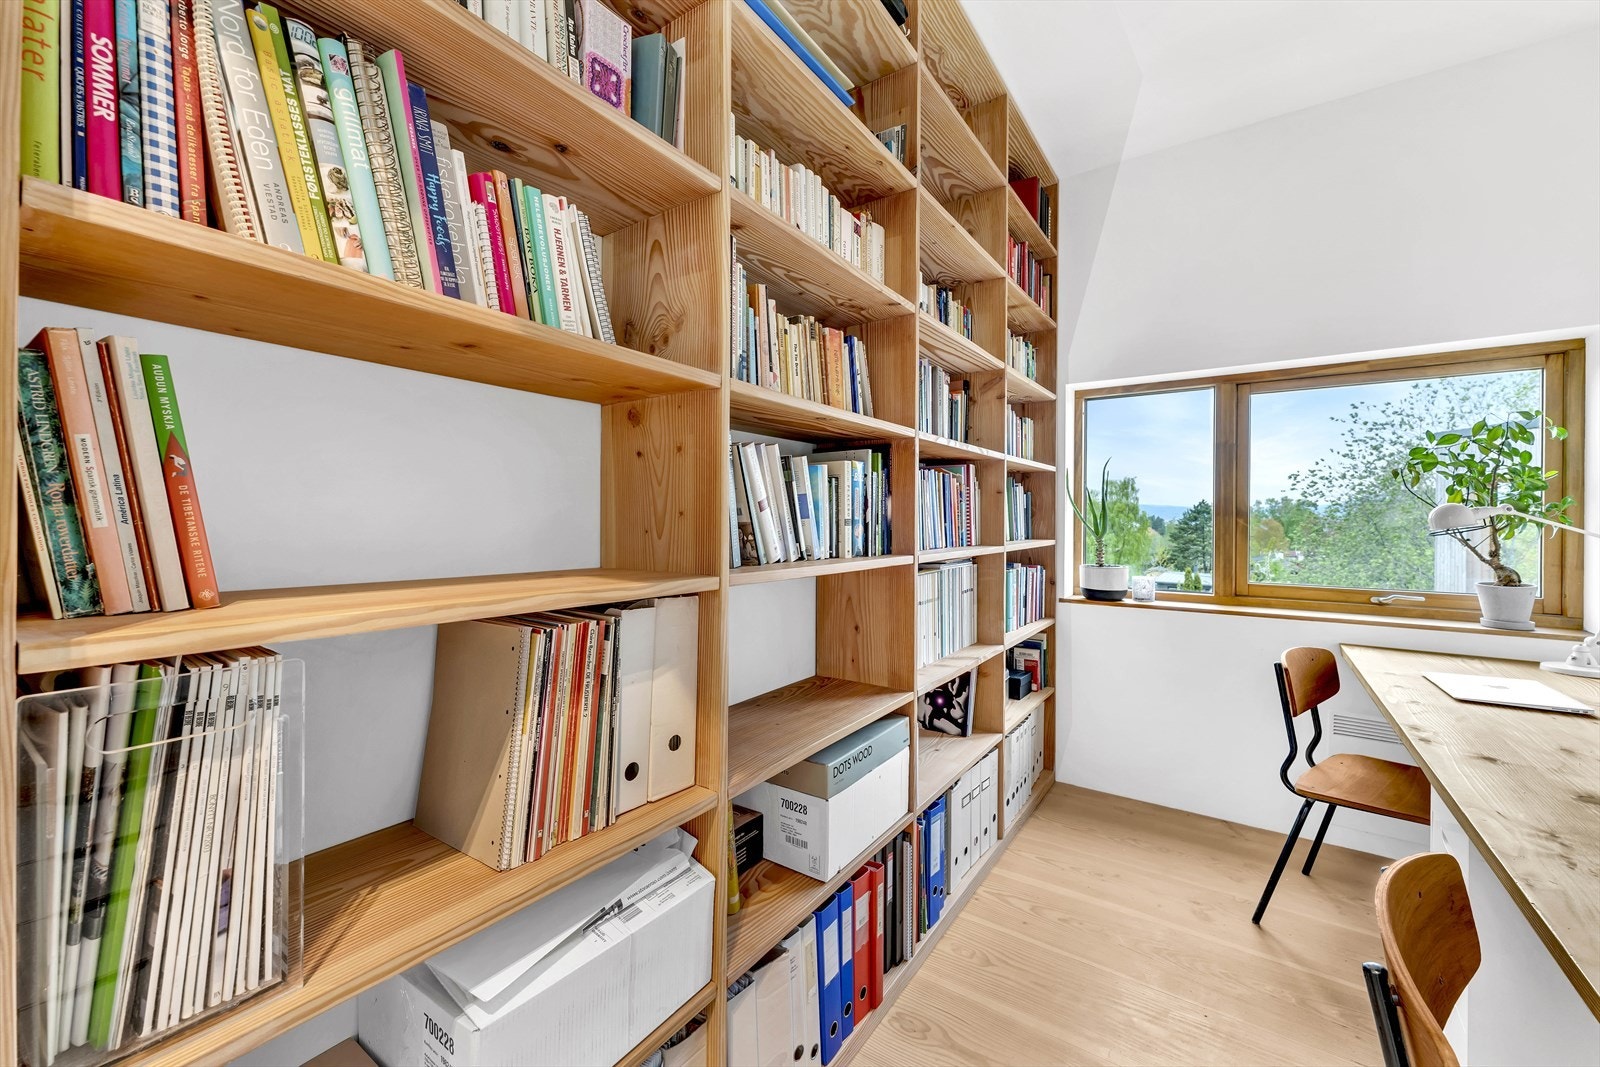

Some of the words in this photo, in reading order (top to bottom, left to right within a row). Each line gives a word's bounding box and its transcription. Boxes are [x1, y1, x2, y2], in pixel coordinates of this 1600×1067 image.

[179, 32, 189, 60] Jorge
[218, 0, 254, 60] Nord
[74, 66, 84, 96] QUICHES
[90, 32, 116, 122] SOMMER
[181, 66, 192, 92] Tapas
[232, 66, 258, 102] for
[280, 68, 294, 96] MAT
[77, 100, 85, 127] PASTRIES
[185, 102, 195, 122] små
[262, 50, 278, 90] Basic
[274, 100, 296, 161] asiatisk
[242, 108, 274, 170] Eden
[334, 88, 370, 170] grillmat
[186, 124, 198, 181] delikatesser
[287, 98, 320, 200] FØRSTEKLASSES
[191, 182, 200, 198] fra
[414, 106, 429, 132] IRINA
[426, 173, 440, 214] Happy
[433, 214, 450, 252] Foods
[263, 183, 278, 222] VIESTAD
[273, 182, 288, 224] ANDREAS
[436, 156, 470, 284] fiskekokeboka
[534, 196, 552, 292] HELSEREVOLUSJONEN
[554, 228, 567, 268] HJERNEN
[528, 258, 538, 294] BOKA
[560, 277, 572, 312] TARMEN
[27, 368, 46, 411] ASTRID
[152, 364, 167, 394] AUDUN
[160, 396, 175, 430] MYSKJA
[35, 414, 59, 474] LINDGREN
[80, 438, 92, 464] MODERN
[86, 466, 97, 490] Spansk
[113, 474, 124, 496] Latina
[178, 484, 190, 496] DE
[18, 454, 26, 478] VERBOS
[32, 514, 44, 552] CONJUGADOS
[44, 482, 66, 516] Ronja
[90, 490, 103, 522] grammatik
[116, 496, 130, 524] América
[182, 498, 200, 547] TIBETANSKE
[56, 518, 80, 580] røverdatter
[193, 550, 207, 578] RITENE
[832, 758, 852, 778] DOTS
[852, 745, 873, 766] WOOD
[780, 798, 808, 816] 700228
[422, 1012, 455, 1055] 700228
